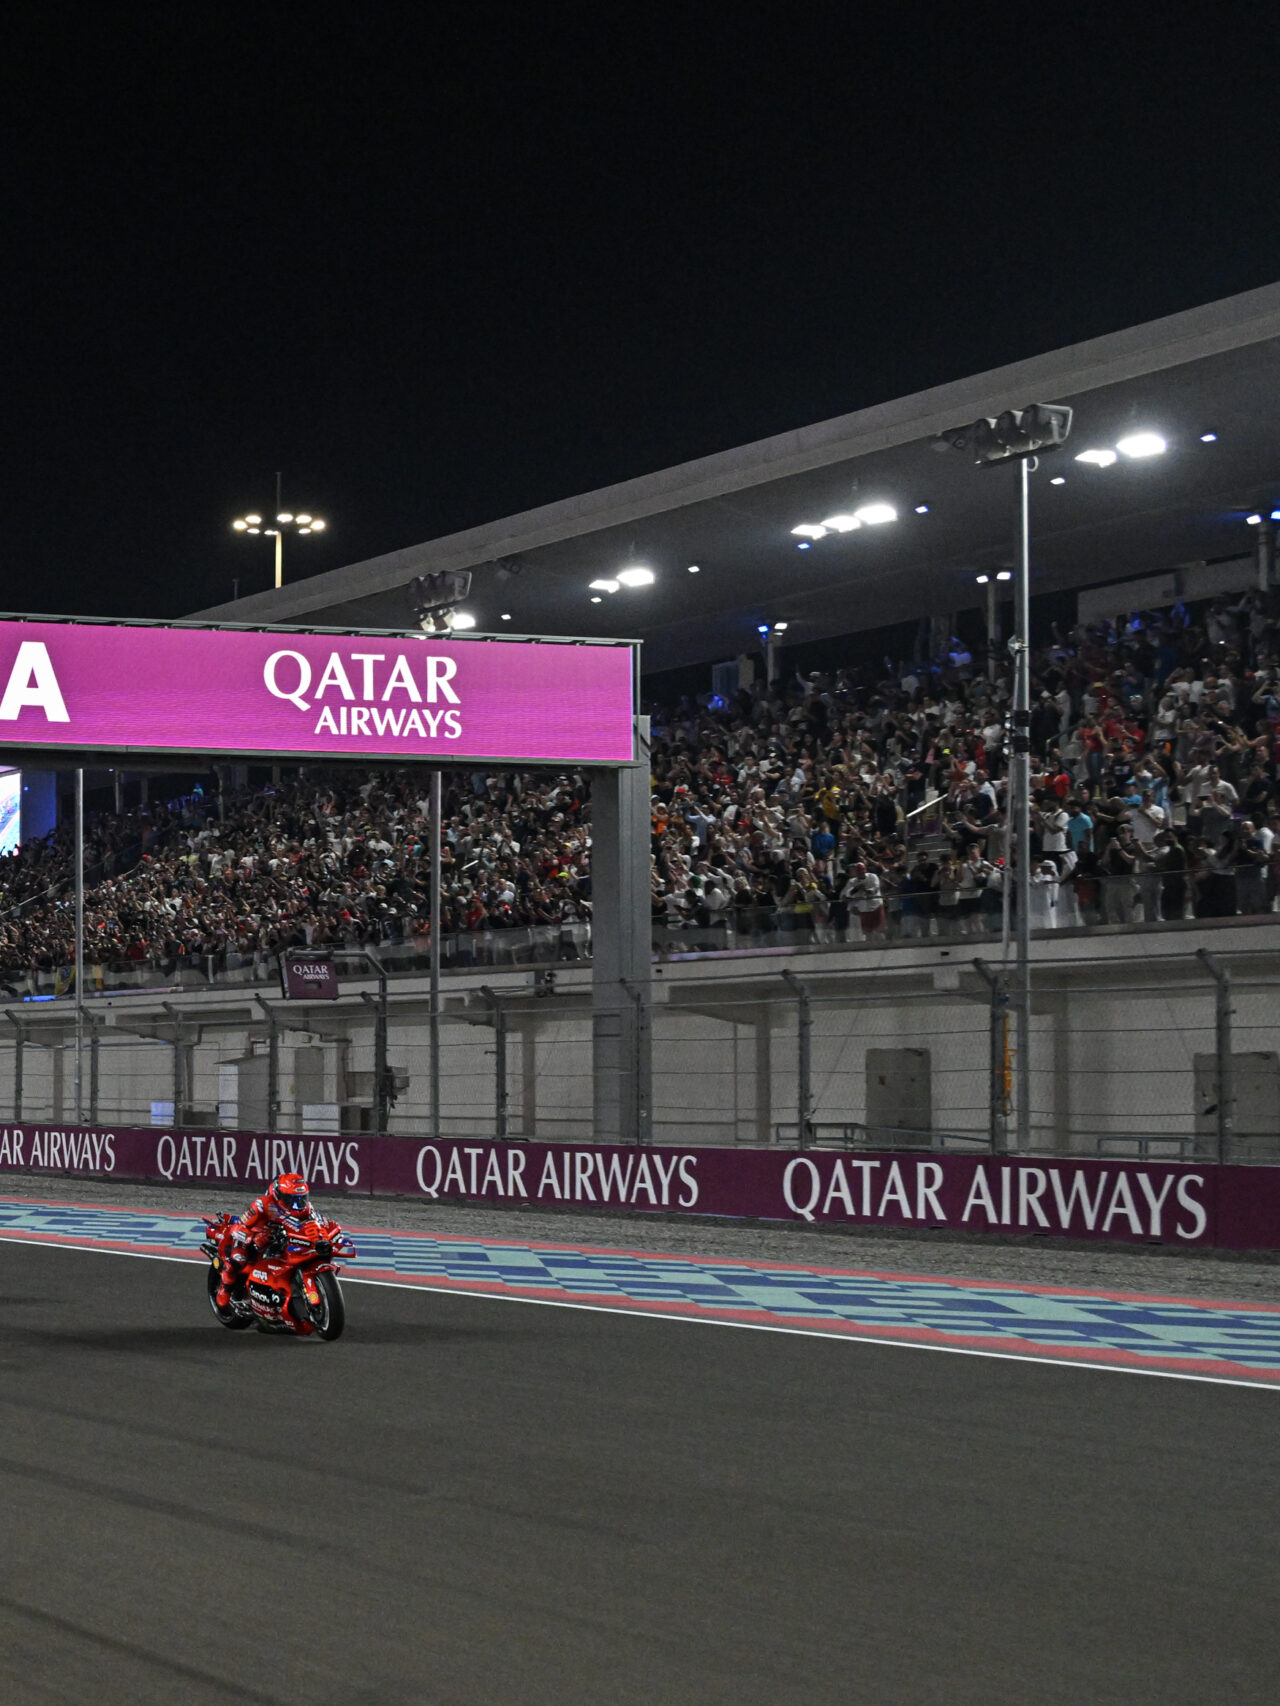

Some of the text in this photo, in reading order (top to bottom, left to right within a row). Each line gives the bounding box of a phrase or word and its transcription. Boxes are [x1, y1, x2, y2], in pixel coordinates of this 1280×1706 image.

[263, 650, 461, 711] QATAR
[314, 705, 462, 739] AIRWAYS
[292, 964, 329, 975] QATAR
[30, 1131, 116, 1172] AIRWAYS
[157, 1136, 360, 1186] QATAR AIRWAYS
[416, 1145, 699, 1208] QATAR AIRWAYS
[782, 1157, 1208, 1240] QATAR AIRWAYS
